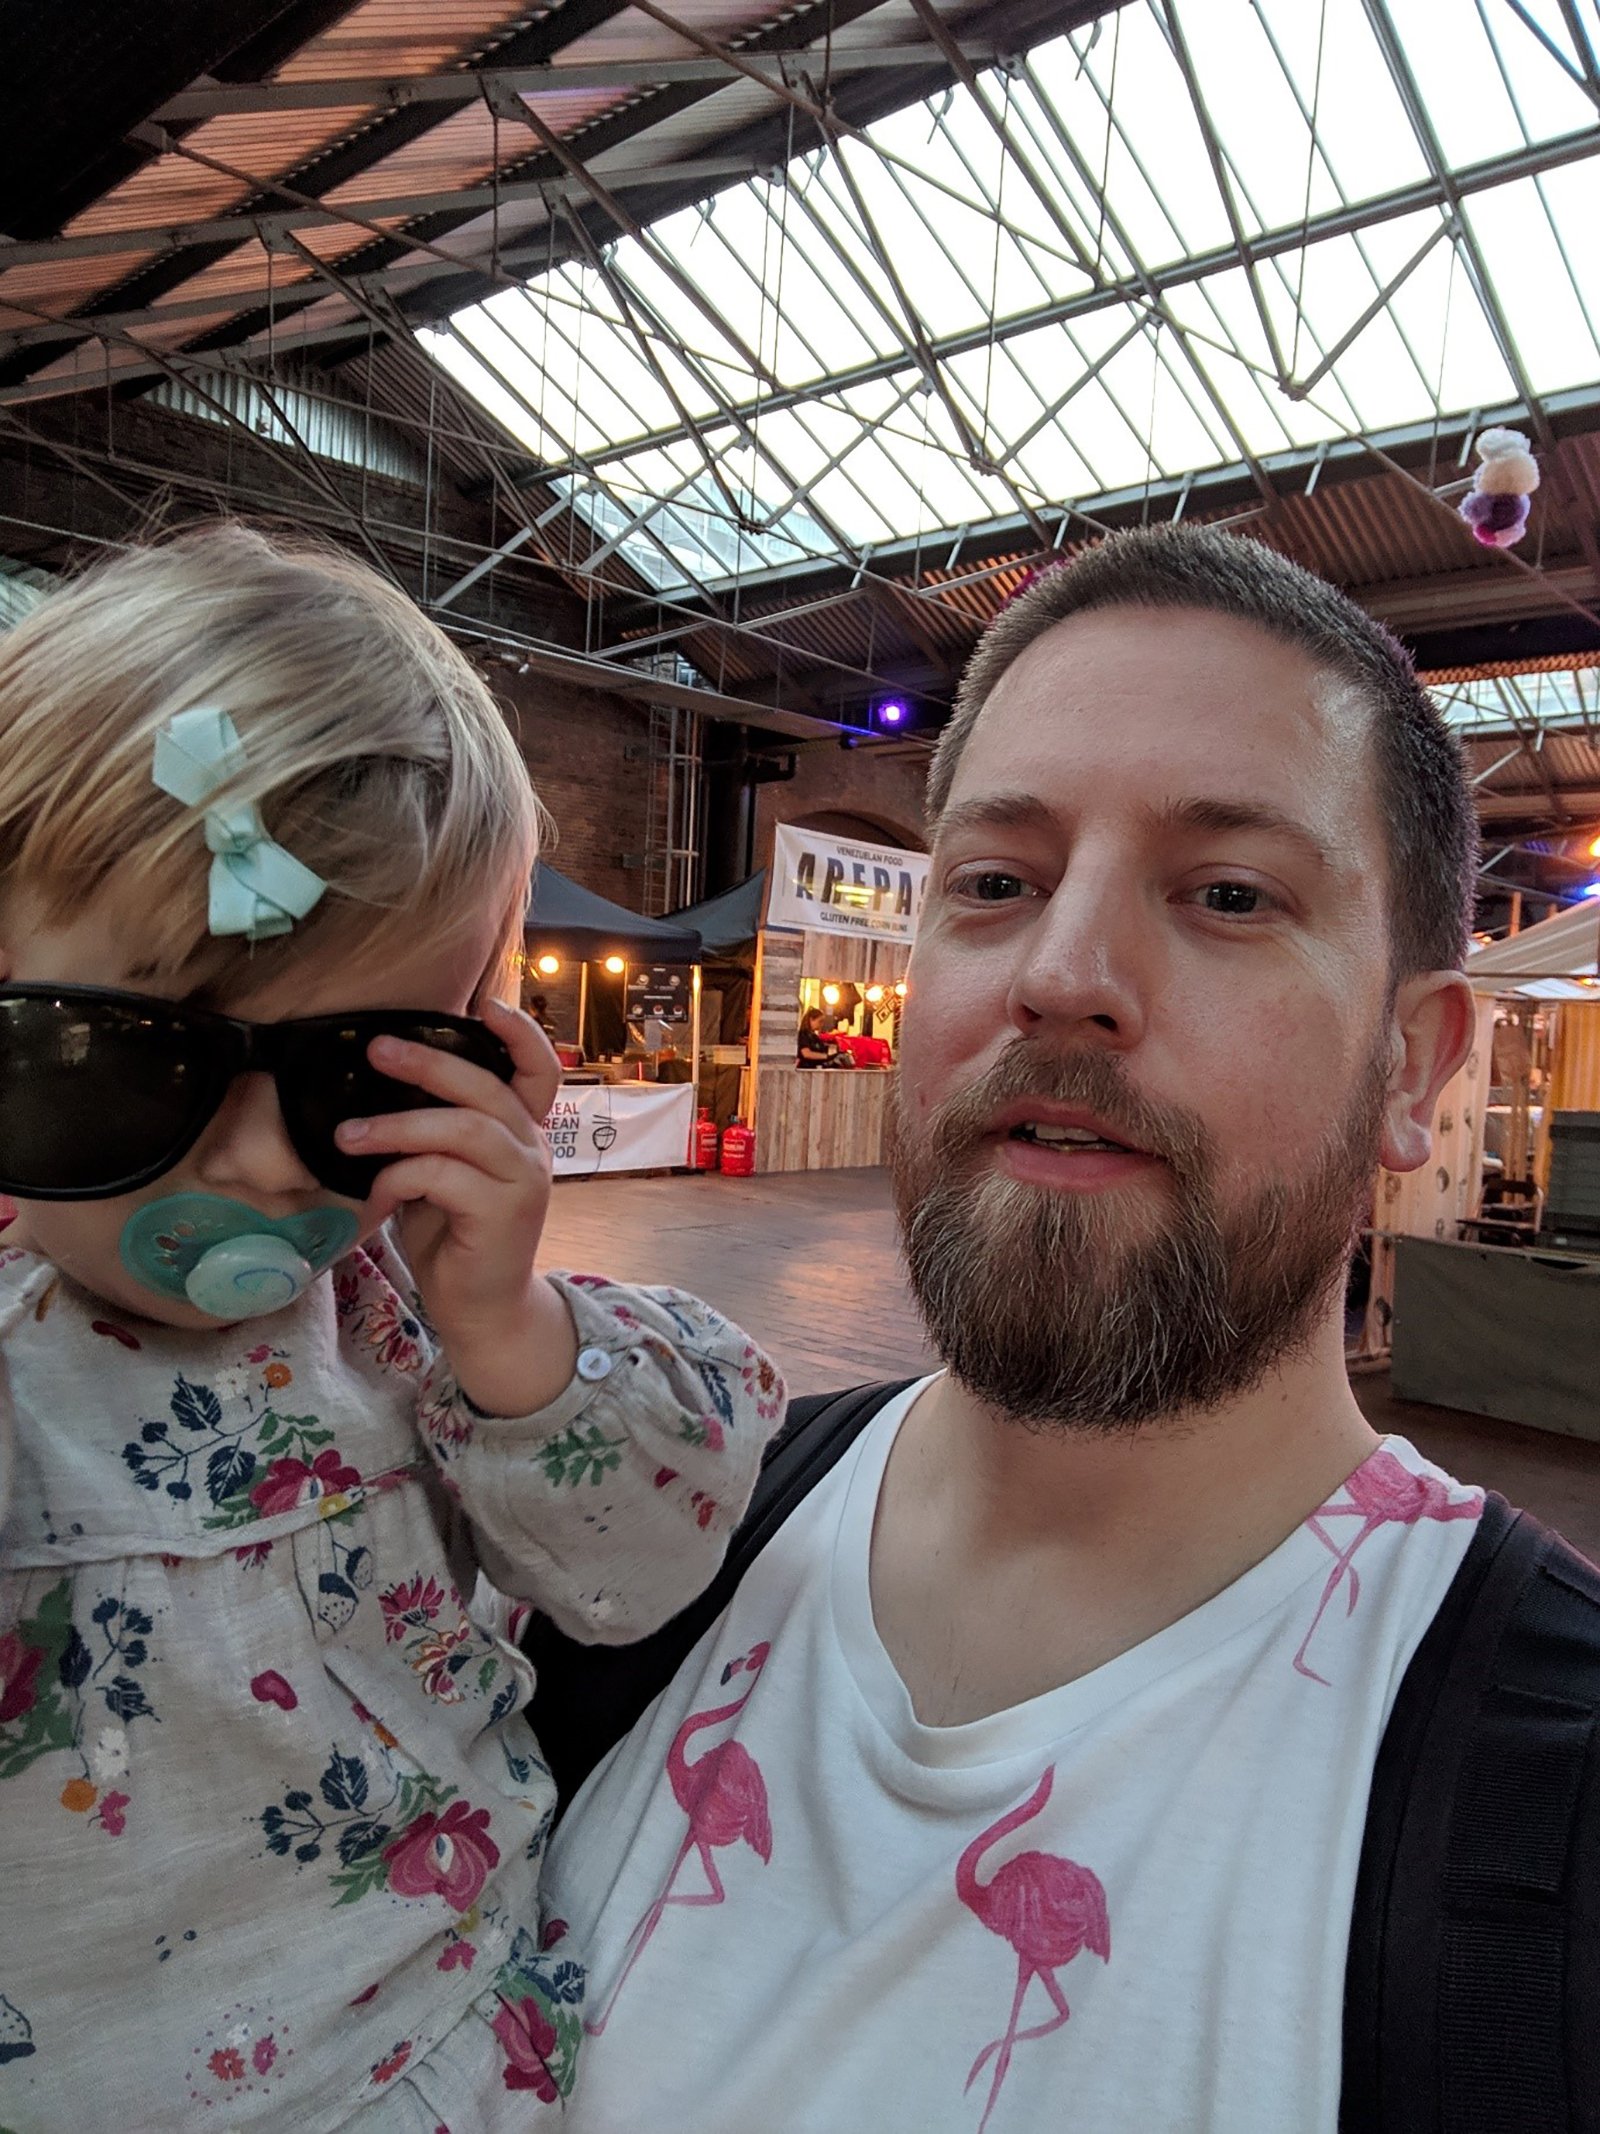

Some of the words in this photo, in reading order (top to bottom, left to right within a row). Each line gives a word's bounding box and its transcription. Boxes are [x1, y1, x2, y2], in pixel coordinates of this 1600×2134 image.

[837, 846, 883, 862] VENEZUELAN
[884, 855, 903, 867] FOOD
[820, 912, 850, 925] GLUTEN
[851, 915, 868, 927] FREE
[542, 1117, 580, 1130] REAN
[546, 1131, 578, 1144] REET
